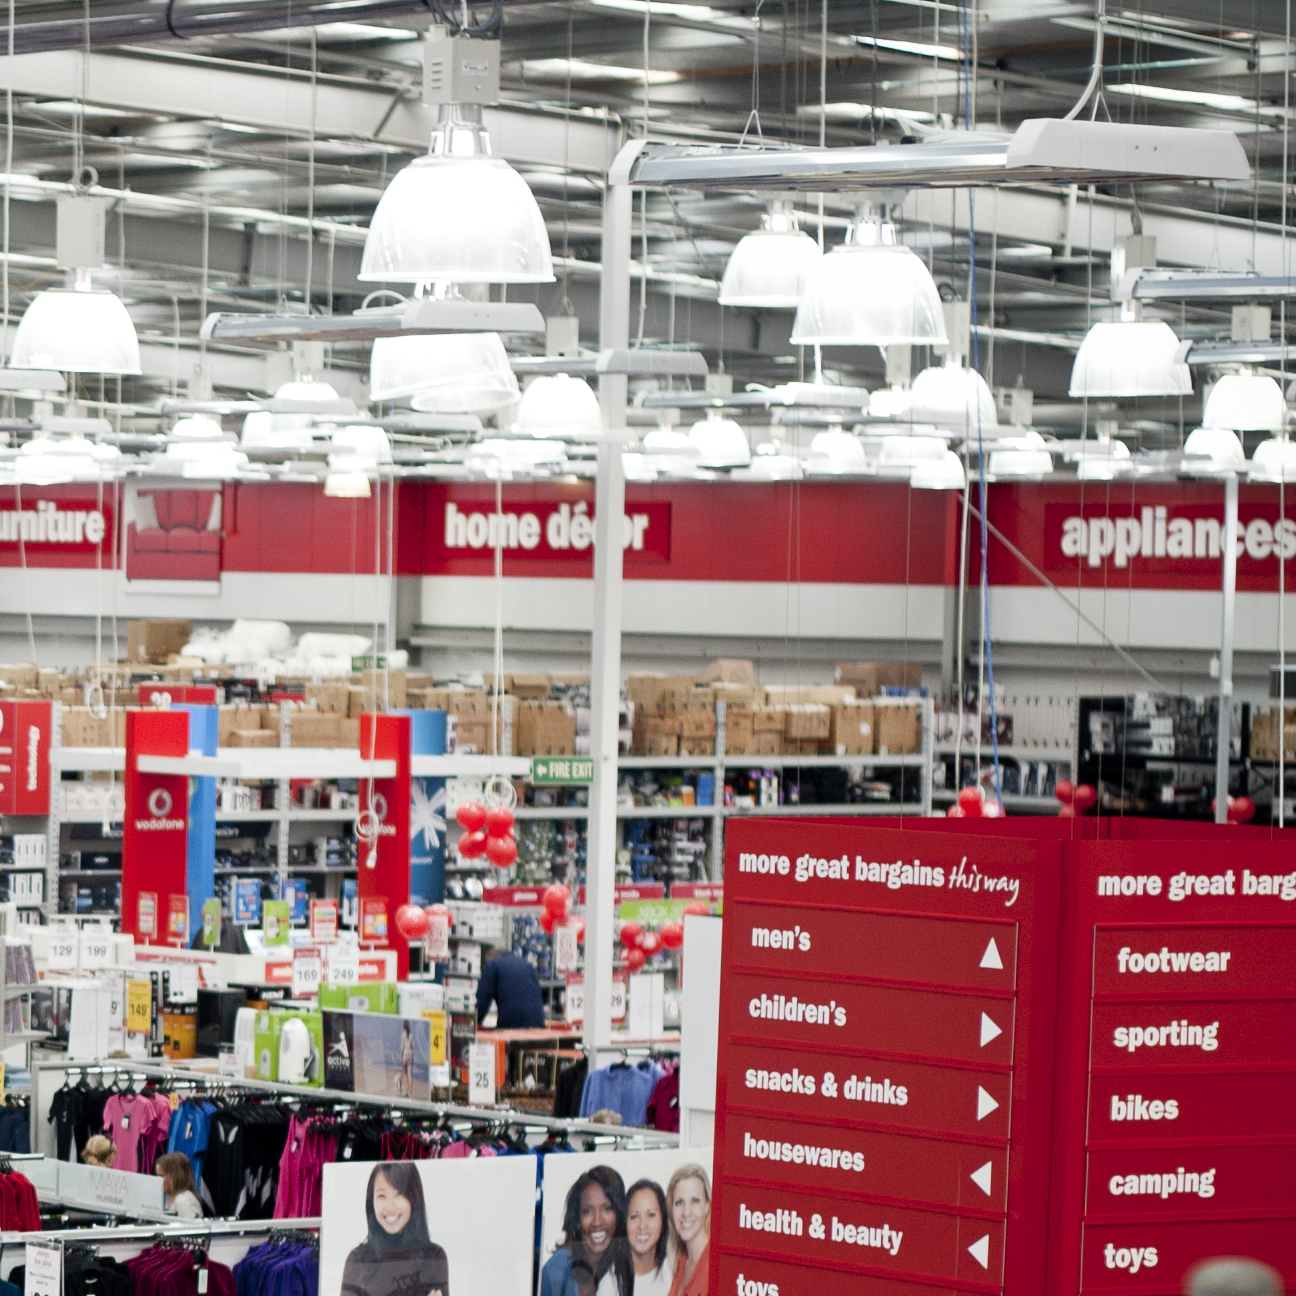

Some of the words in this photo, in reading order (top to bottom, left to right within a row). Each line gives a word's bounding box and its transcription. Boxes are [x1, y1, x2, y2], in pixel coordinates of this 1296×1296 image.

[444, 503, 540, 551] home
[547, 501, 649, 551] déor
[1062, 504, 1296, 569] appliances
[549, 758, 570, 782] FIRE
[572, 758, 593, 781] EXIT
[136, 818, 184, 830] vodafone
[739, 851, 790, 876] more
[795, 855, 849, 881] great
[855, 859, 945, 890] bargains
[1098, 874, 1161, 896] more
[1169, 870, 1235, 901] great
[1118, 946, 1230, 973] footwear
[1114, 1021, 1219, 1051] sporting
[745, 1068, 816, 1095] snacks
[822, 1073, 837, 1099] &
[844, 1076, 908, 1106] drinks
[1111, 1096, 1178, 1121] bikes
[744, 1133, 864, 1172] housewares
[1109, 1168, 1215, 1199] camping
[739, 1205, 803, 1236] health
[809, 1214, 825, 1240] &
[831, 1220, 903, 1256] beauty
[1105, 1244, 1158, 1274] toys
